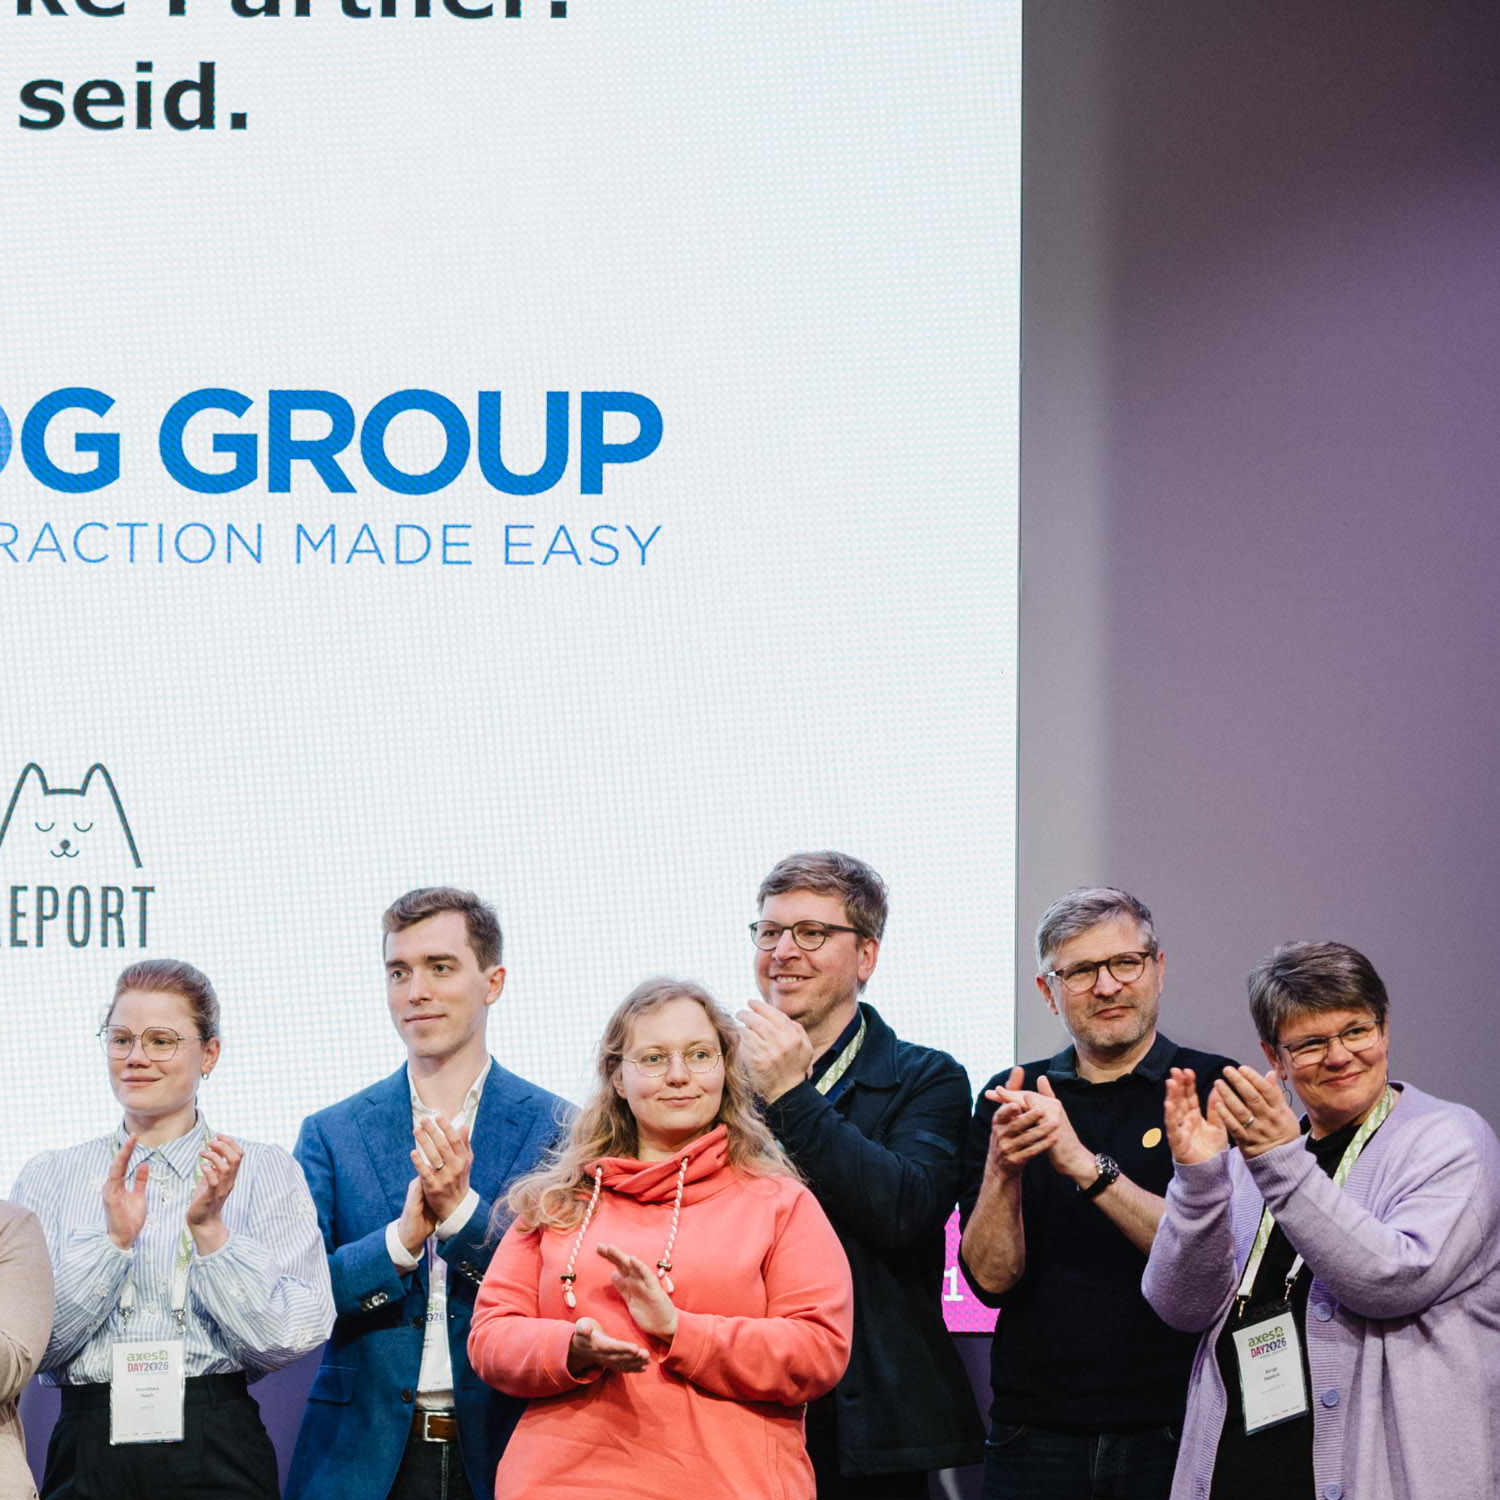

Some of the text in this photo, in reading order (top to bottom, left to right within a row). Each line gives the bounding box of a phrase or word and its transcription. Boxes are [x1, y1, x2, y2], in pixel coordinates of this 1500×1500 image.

[19, 61, 247, 131] seid.
[159, 388, 664, 496] GROUP
[296, 523, 472, 565] MADE
[504, 524, 662, 566] EASY
[943, 1265, 964, 1302] 1
